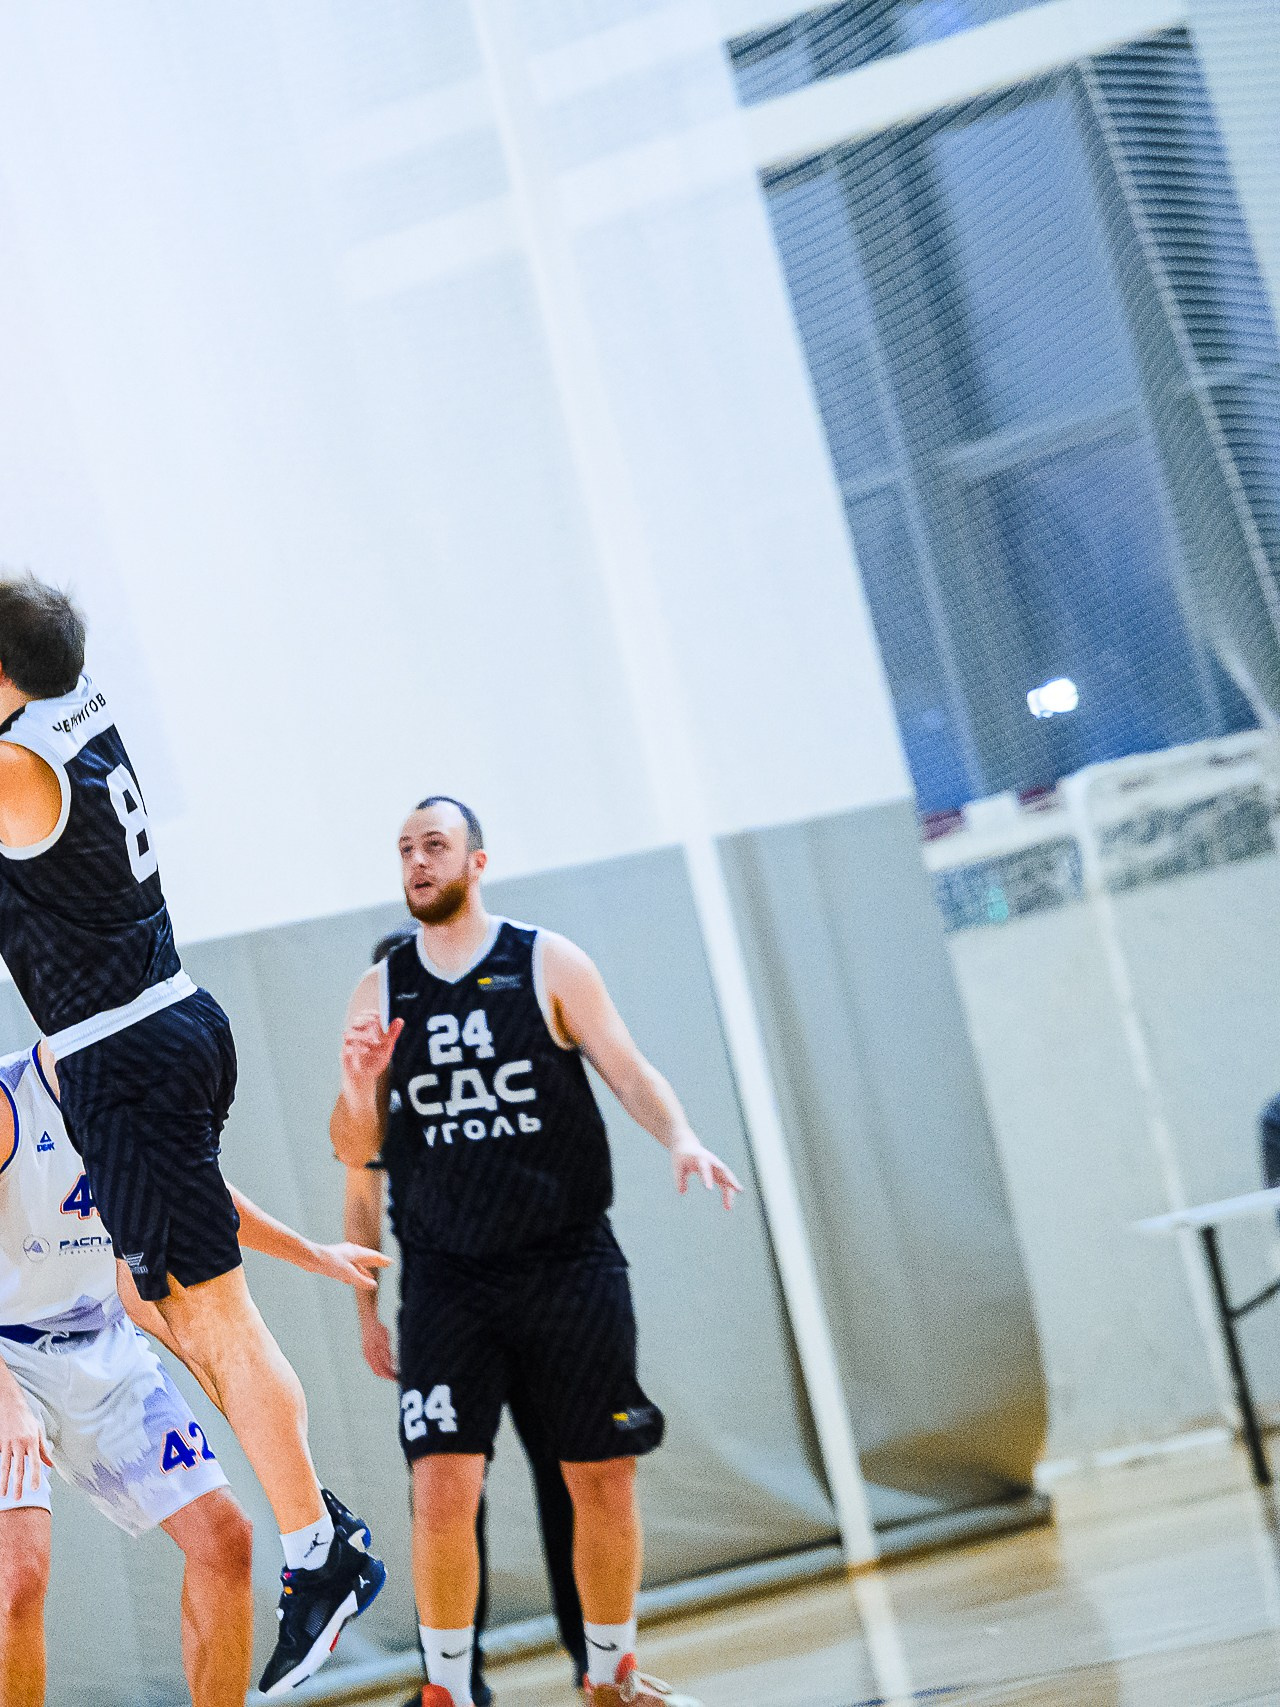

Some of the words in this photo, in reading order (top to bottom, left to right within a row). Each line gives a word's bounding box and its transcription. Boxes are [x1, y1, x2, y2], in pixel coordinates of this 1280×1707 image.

[106, 763, 158, 884] 8
[426, 1009, 495, 1066] 24
[407, 1059, 537, 1117] СДС
[423, 1112, 542, 1148] УГОЛЬ
[59, 1171, 101, 1220] 4
[400, 1384, 458, 1441] 24
[159, 1420, 216, 1474] 42
